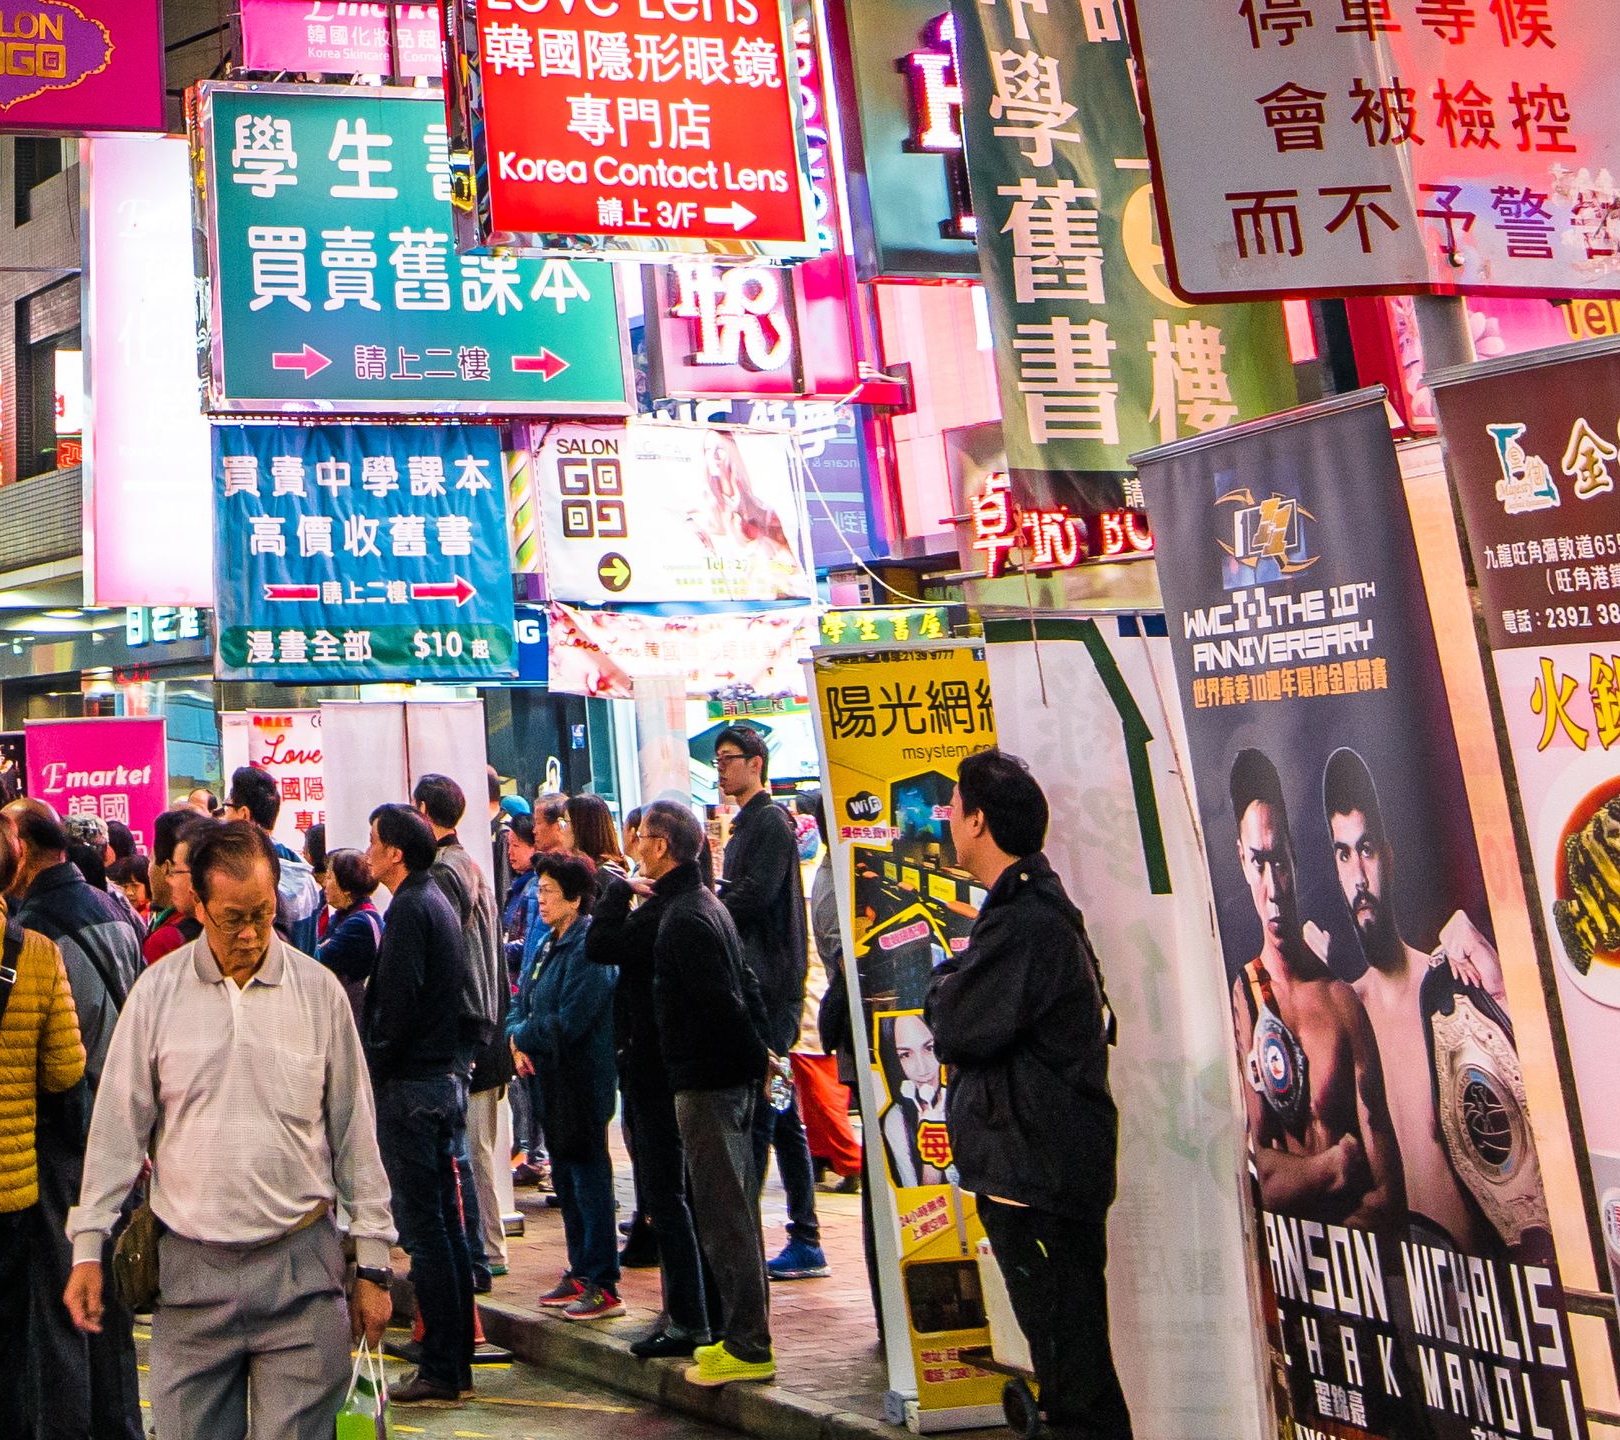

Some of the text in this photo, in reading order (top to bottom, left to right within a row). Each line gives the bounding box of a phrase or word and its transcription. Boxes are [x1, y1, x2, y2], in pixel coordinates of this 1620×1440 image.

[484, 22, 781, 90] 韓國隱形眼鏡
[565, 92, 712, 151] 專門店
[1256, 79, 1579, 157] 會被檢控
[499, 152, 788, 193] Korea Contact Lens
[596, 197, 698, 231] 請上 3/F
[353, 344, 490, 382] 請上二樓
[557, 438, 620, 456] SALON
[223, 453, 493, 499] 買賣中學課本
[249, 513, 474, 559] 高價收舊書
[246, 629, 492, 663] 漫畫全部 $10 起
[1192, 620, 1376, 673] ANNIVERSARY
[1401, 1242, 1565, 1369] MICHALIS
